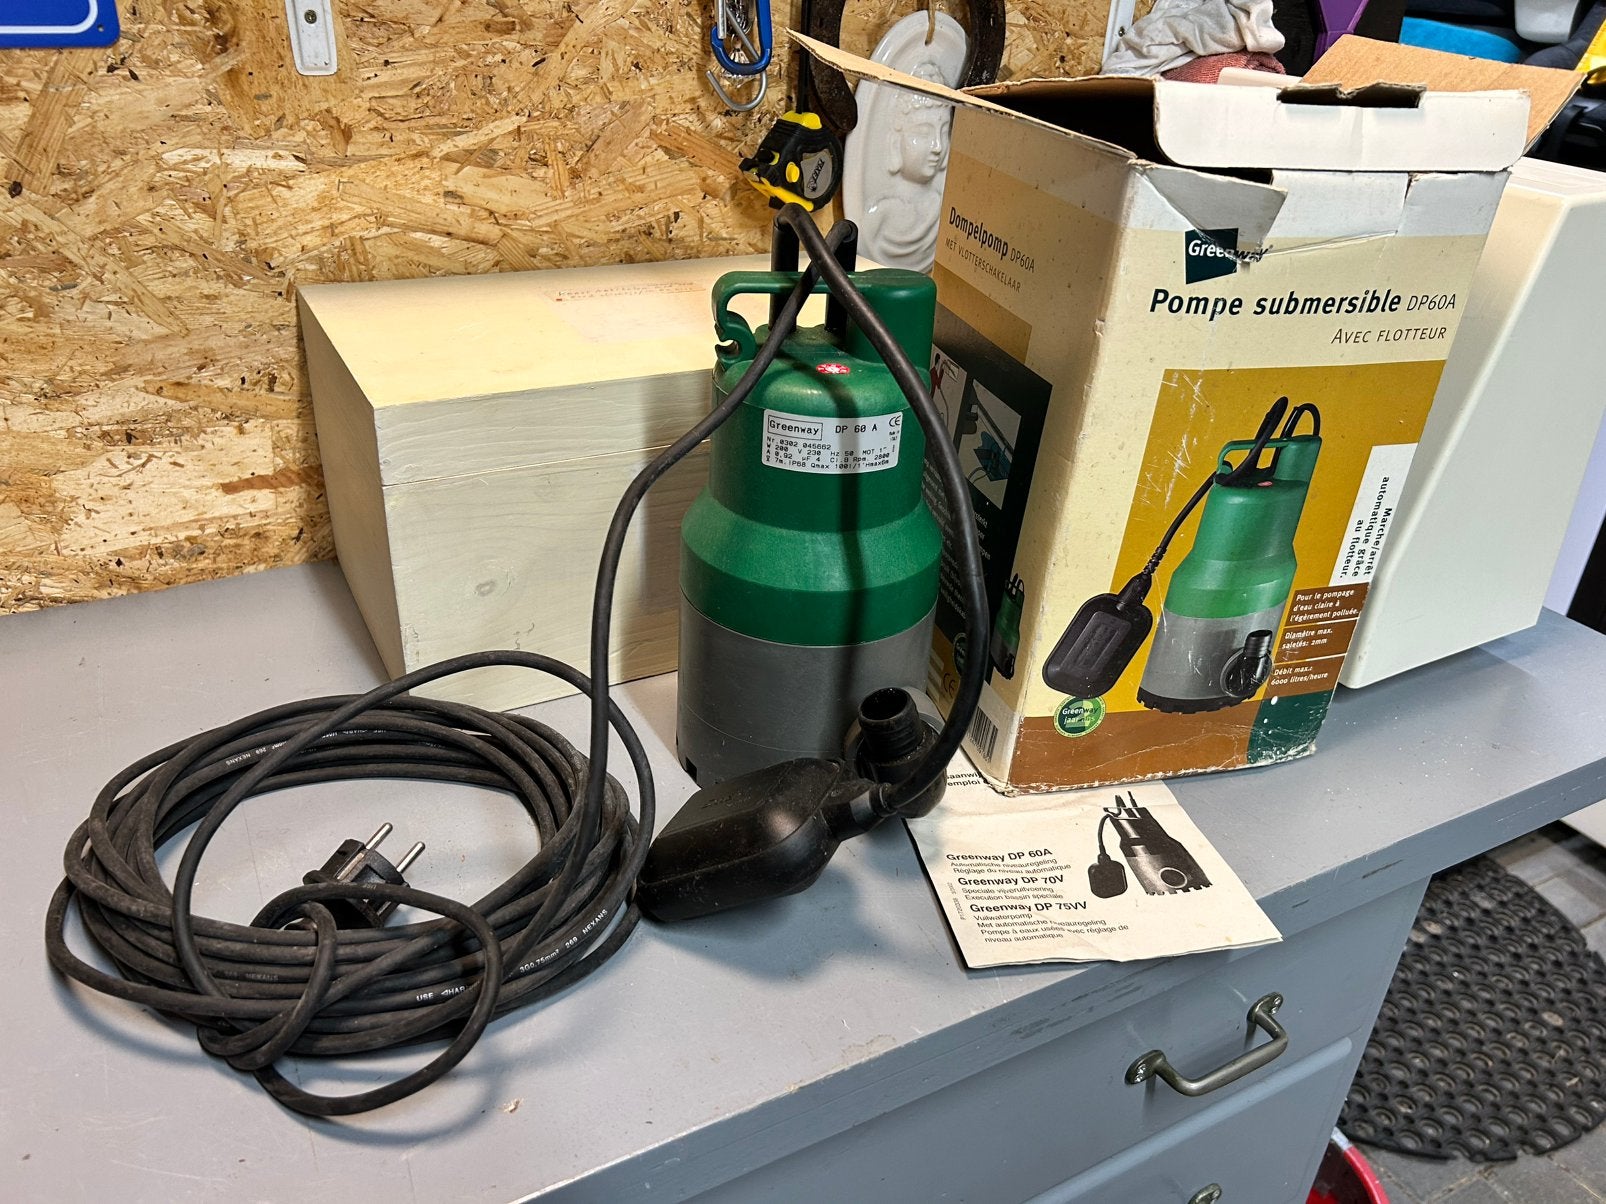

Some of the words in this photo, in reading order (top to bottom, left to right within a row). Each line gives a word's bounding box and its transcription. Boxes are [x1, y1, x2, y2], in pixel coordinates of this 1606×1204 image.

[949, 207, 1009, 260] Dompelpomp
[1010, 248, 1035, 273] DP60A
[945, 238, 957, 251] MET
[958, 246, 1021, 293] VLOTTERSCHAKELAAR
[1149, 288, 1243, 321] Pompe
[1253, 288, 1401, 315] submersible
[1406, 293, 1457, 312] DP60A
[1331, 328, 1372, 344] AVEC
[1377, 327, 1448, 343] FLOTTEUR
[769, 419, 820, 435] Greenway
[835, 425, 848, 434] DP
[854, 424, 867, 433] 60
[871, 423, 878, 431] A
[1363, 476, 1389, 544] automatique
[1354, 519, 1364, 532] au
[1364, 508, 1392, 575] Marche/arrêt
[1340, 537, 1361, 578] flotteur.
[1352, 548, 1366, 577] grâce
[1314, 592, 1321, 600] le
[1323, 589, 1355, 600] pompage
[1293, 604, 1313, 612] d'eau
[1317, 628, 1333, 636] max.
[1311, 638, 1328, 646] 2mm
[1273, 667, 1293, 676] Débit
[1270, 678, 1288, 686] 6000
[1290, 672, 1329, 683] litres/heure
[1062, 707, 1099, 715] Greenway
[946, 853, 1005, 862] Greenway
[1008, 851, 1025, 860] DP
[1028, 848, 1053, 858] 60A
[1024, 864, 1072, 874] automatique
[957, 877, 1019, 886] Greenway
[1021, 876, 1039, 884] DP
[1041, 874, 1065, 884] 70V
[969, 903, 1032, 913] Greenway
[1034, 902, 1053, 912] DP
[582, 908, 609, 935] NEXANS
[973, 912, 1033, 921] Vuilwaterpomp
[994, 918, 1048, 928] automatische
[980, 928, 1011, 936] Pompe
[1086, 925, 1117, 935] réglage
[1014, 933, 1064, 943] automatique
[416, 992, 434, 1002] USE
